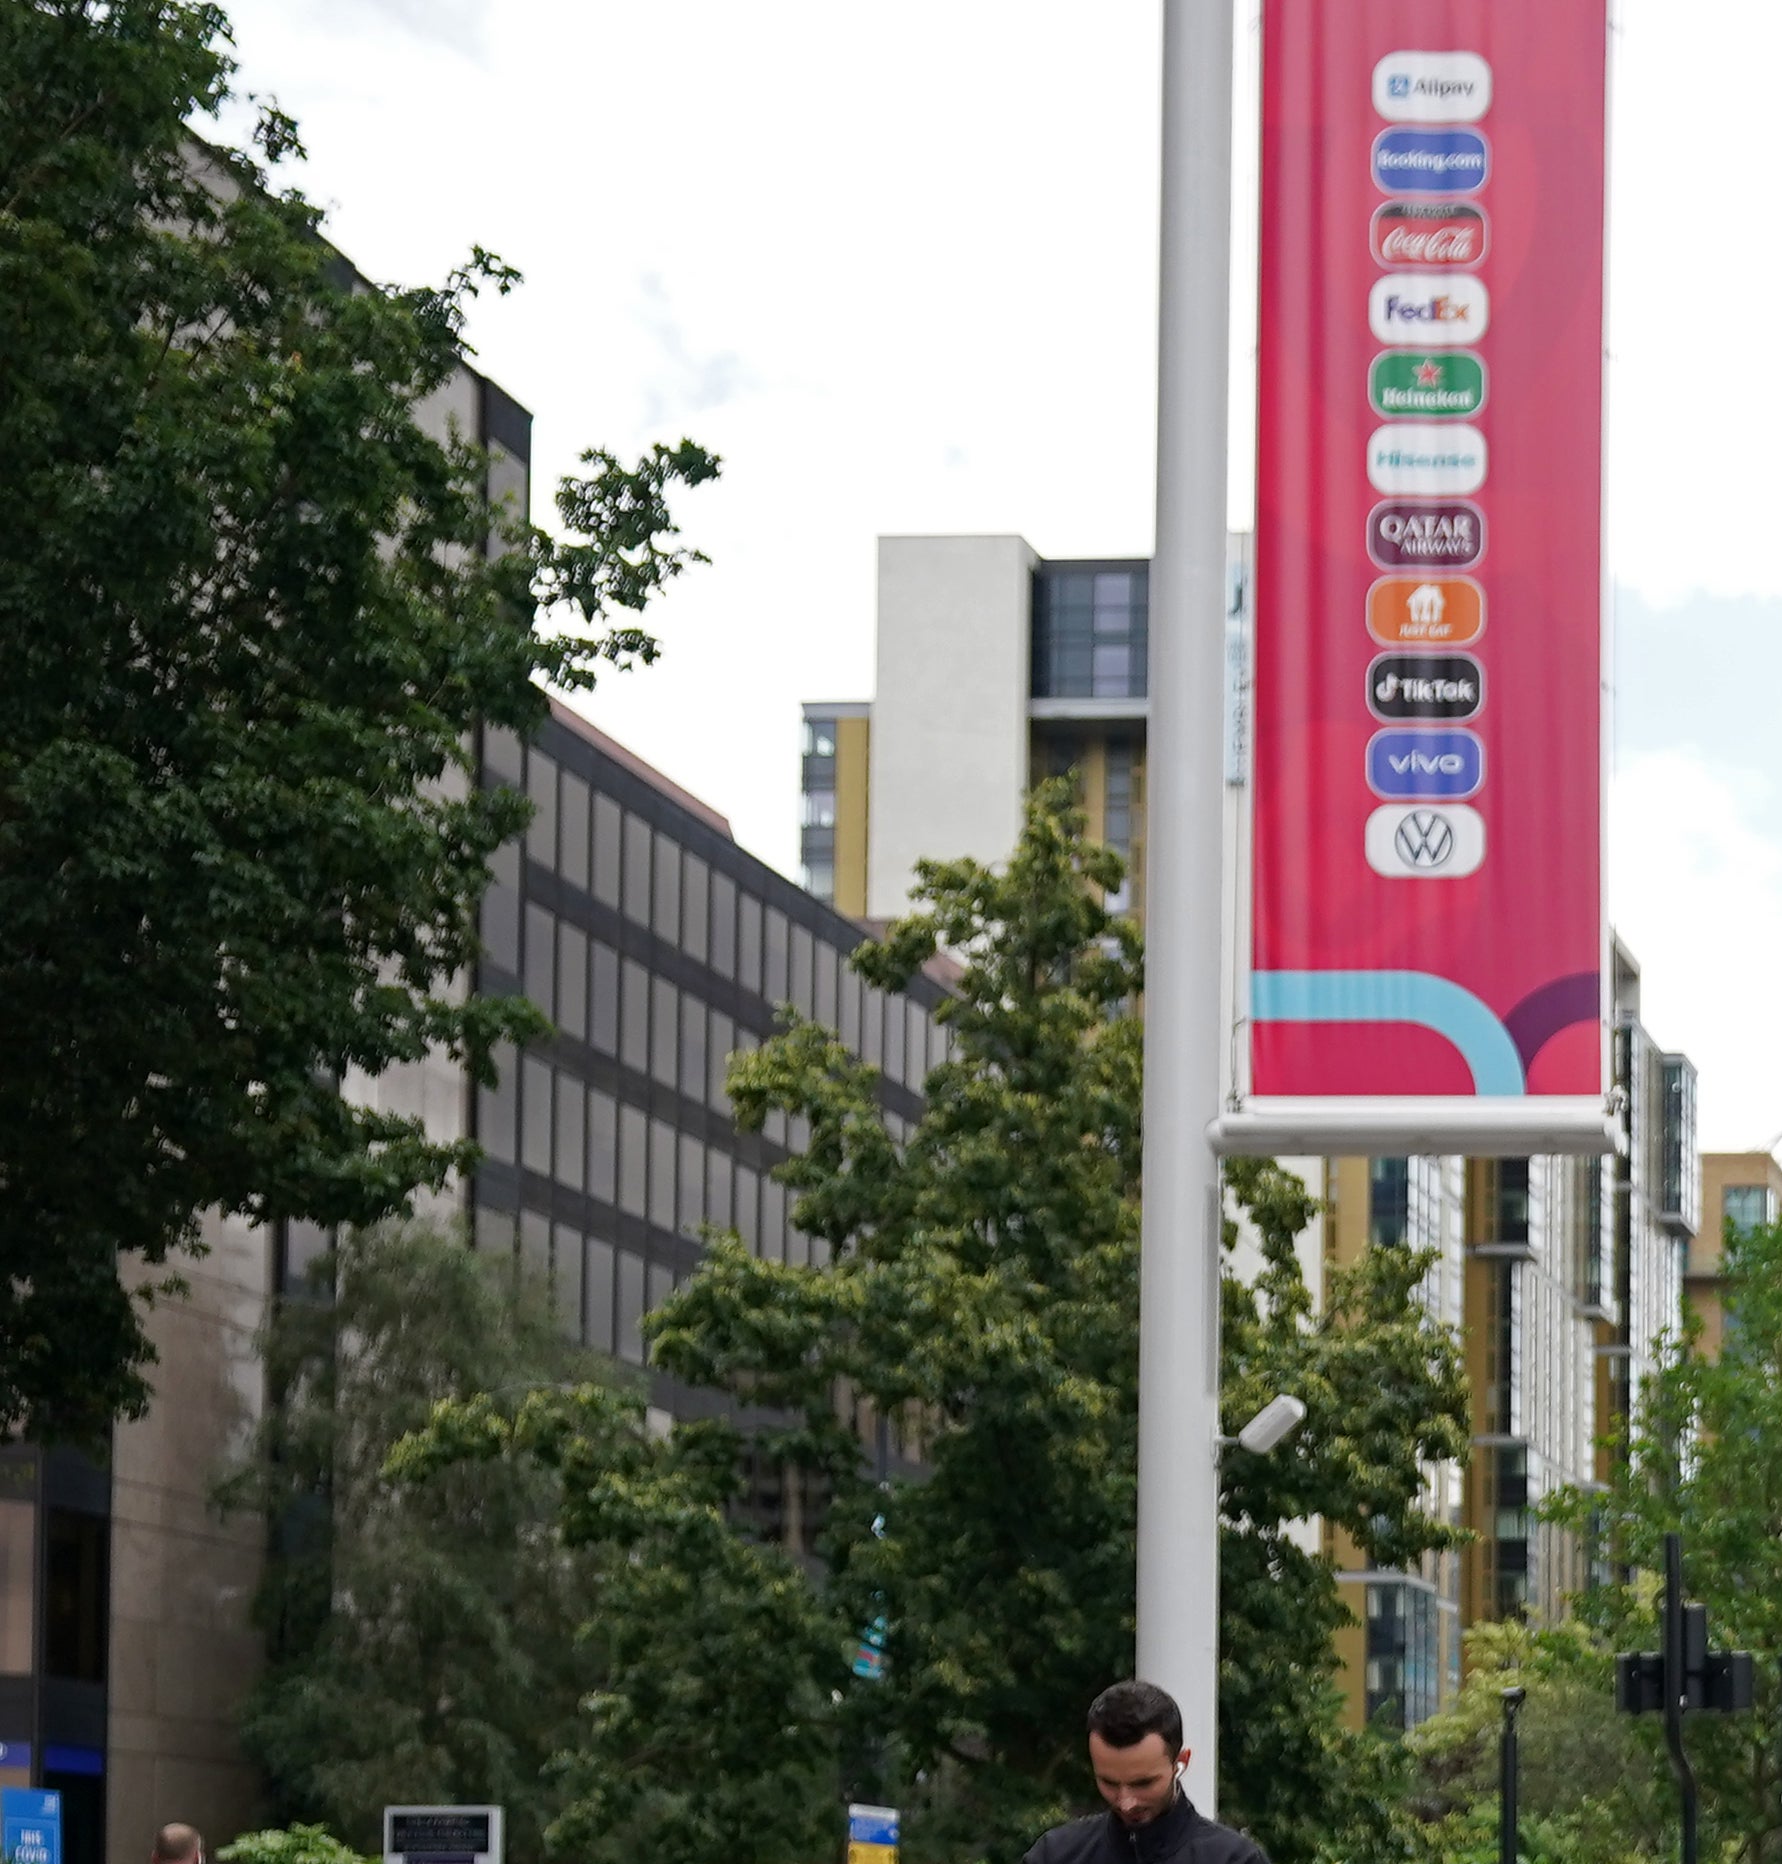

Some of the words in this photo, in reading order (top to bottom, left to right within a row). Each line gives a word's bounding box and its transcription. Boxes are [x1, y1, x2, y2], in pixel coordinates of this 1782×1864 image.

[1414, 74, 1474, 99] Alipay
[1377, 147, 1482, 171] Booking.com
[1386, 296, 1470, 322] FedEx
[1382, 386, 1472, 408] Heineken
[1380, 515, 1473, 548] QATAR
[1400, 539, 1473, 555] AIRWAYS
[1401, 679, 1476, 702] TikTok
[1389, 754, 1465, 775] vivo
